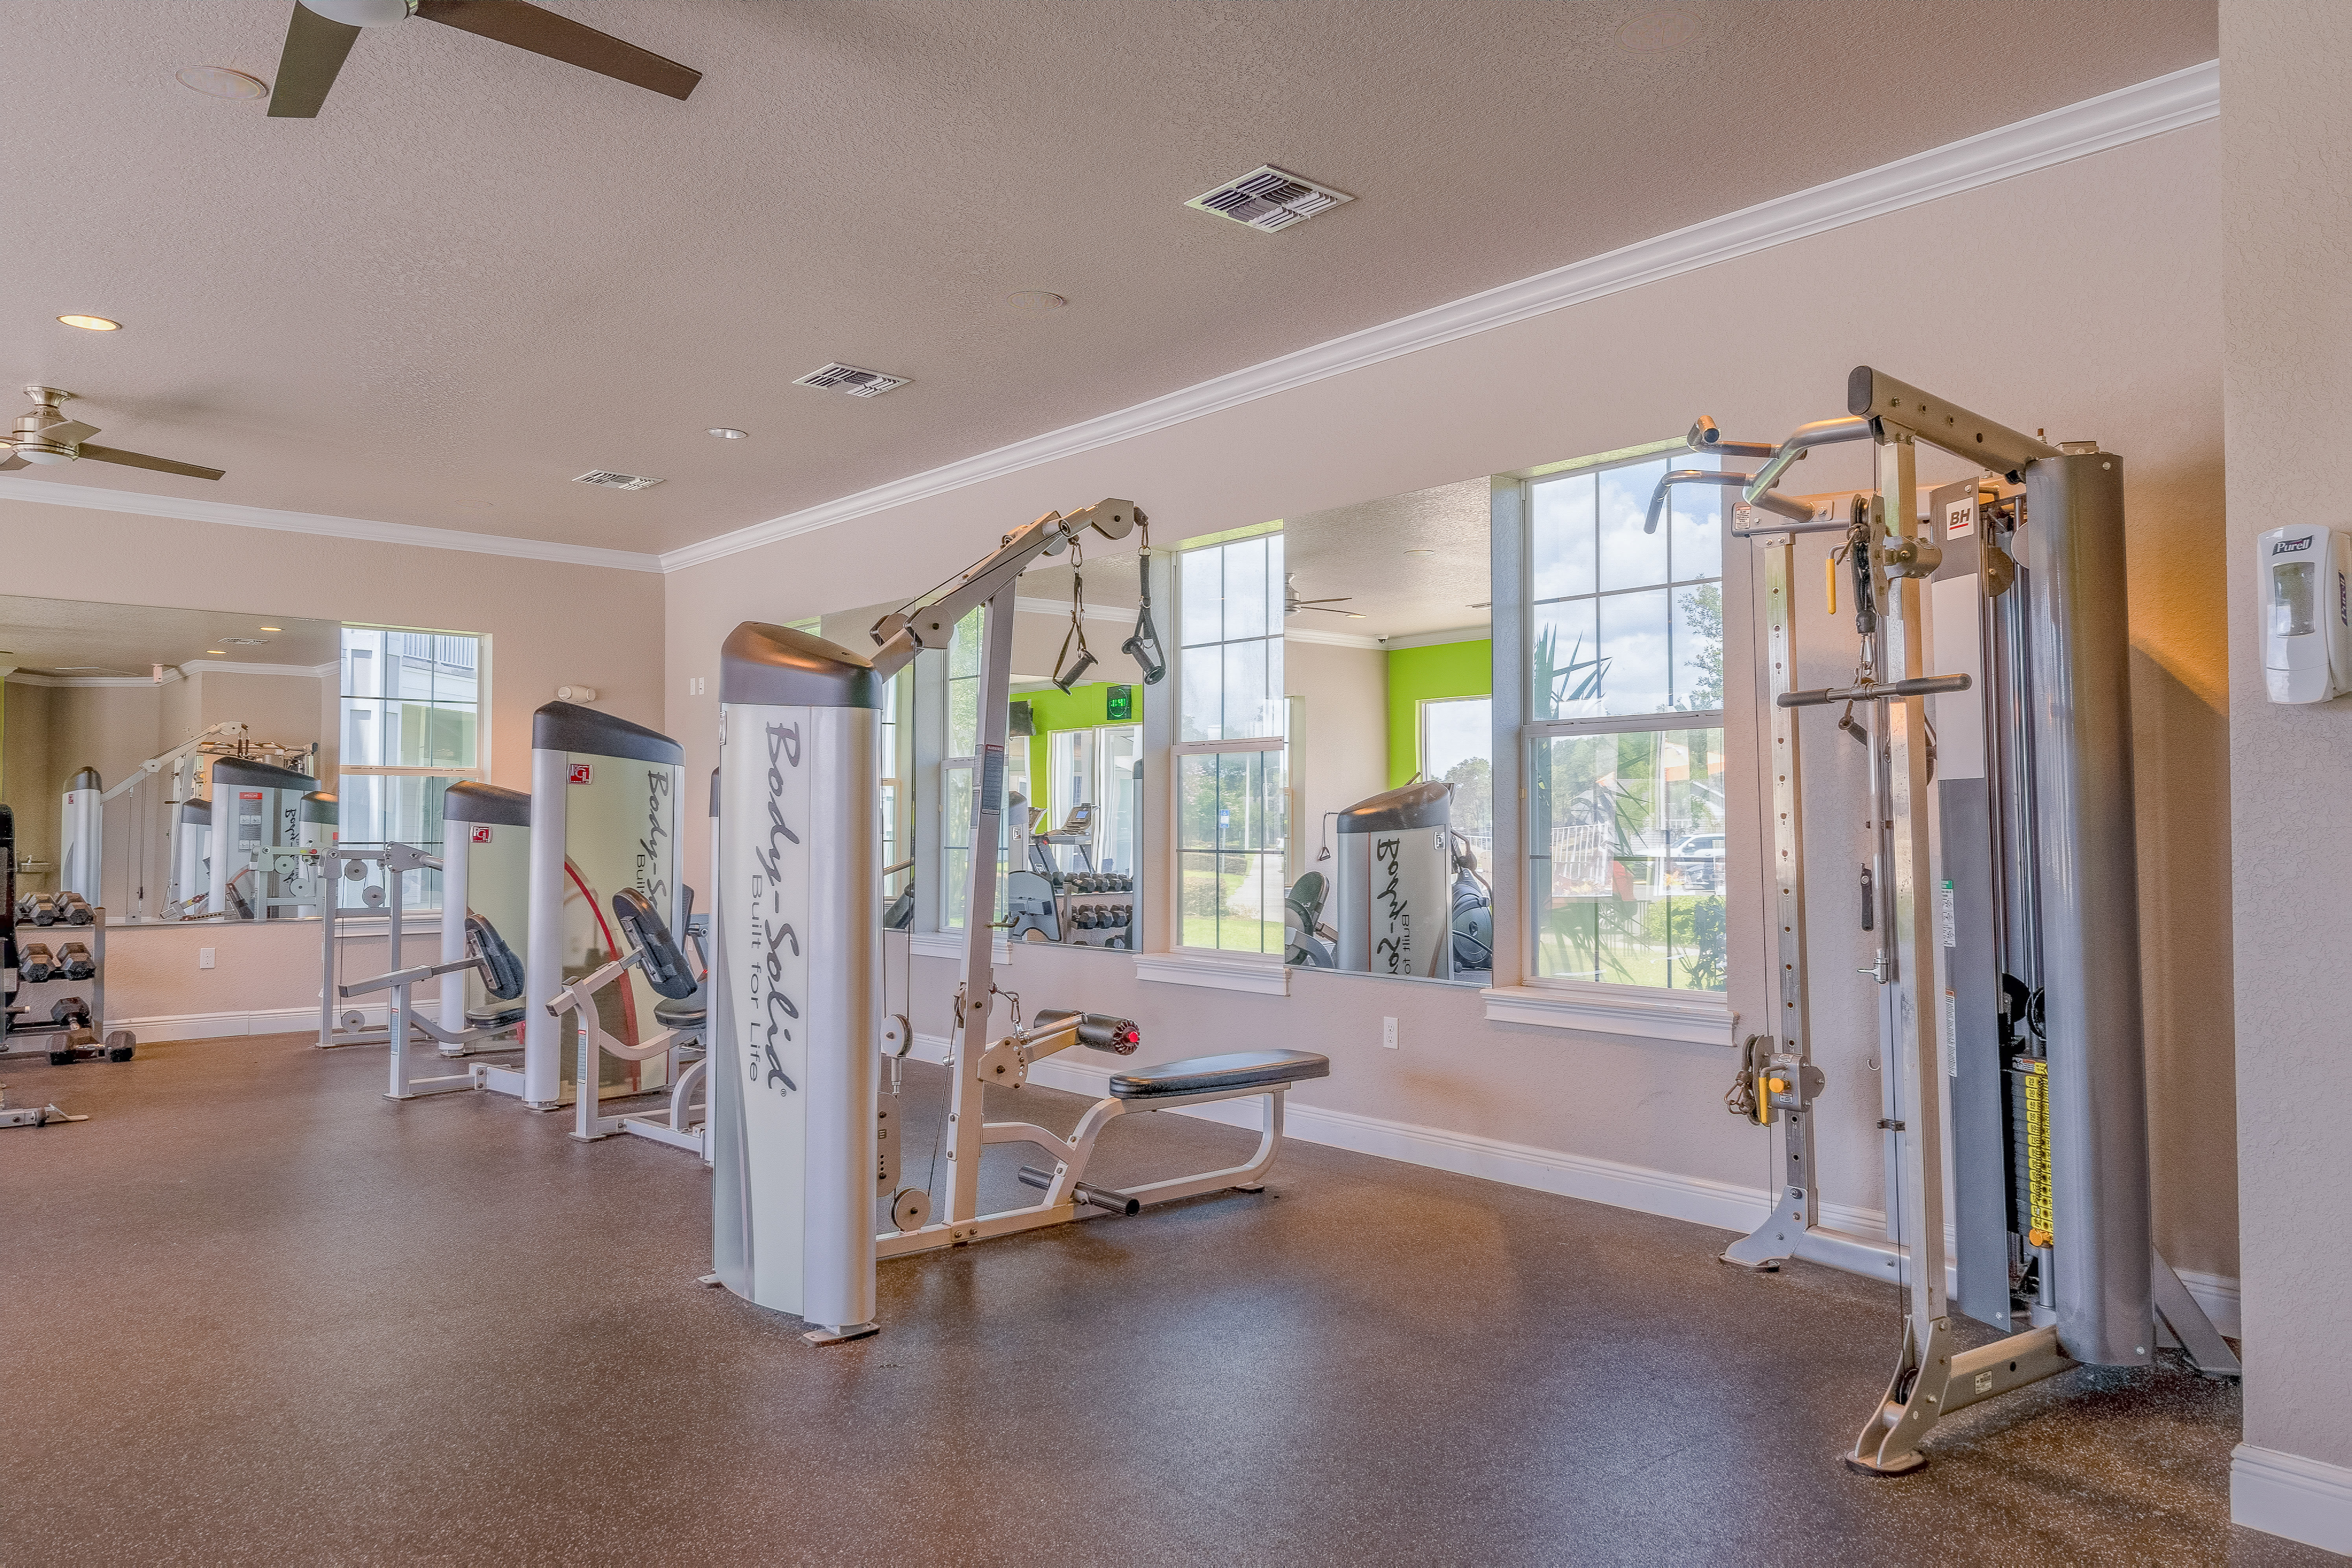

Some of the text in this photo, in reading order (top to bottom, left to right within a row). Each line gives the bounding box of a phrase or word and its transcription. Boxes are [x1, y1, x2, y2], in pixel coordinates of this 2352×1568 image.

[1950, 508, 1971, 526] BH
[2276, 539, 2310, 552] Purell
[756, 721, 801, 1091] Body-Solid
[750, 875, 762, 1082] Built for Life
